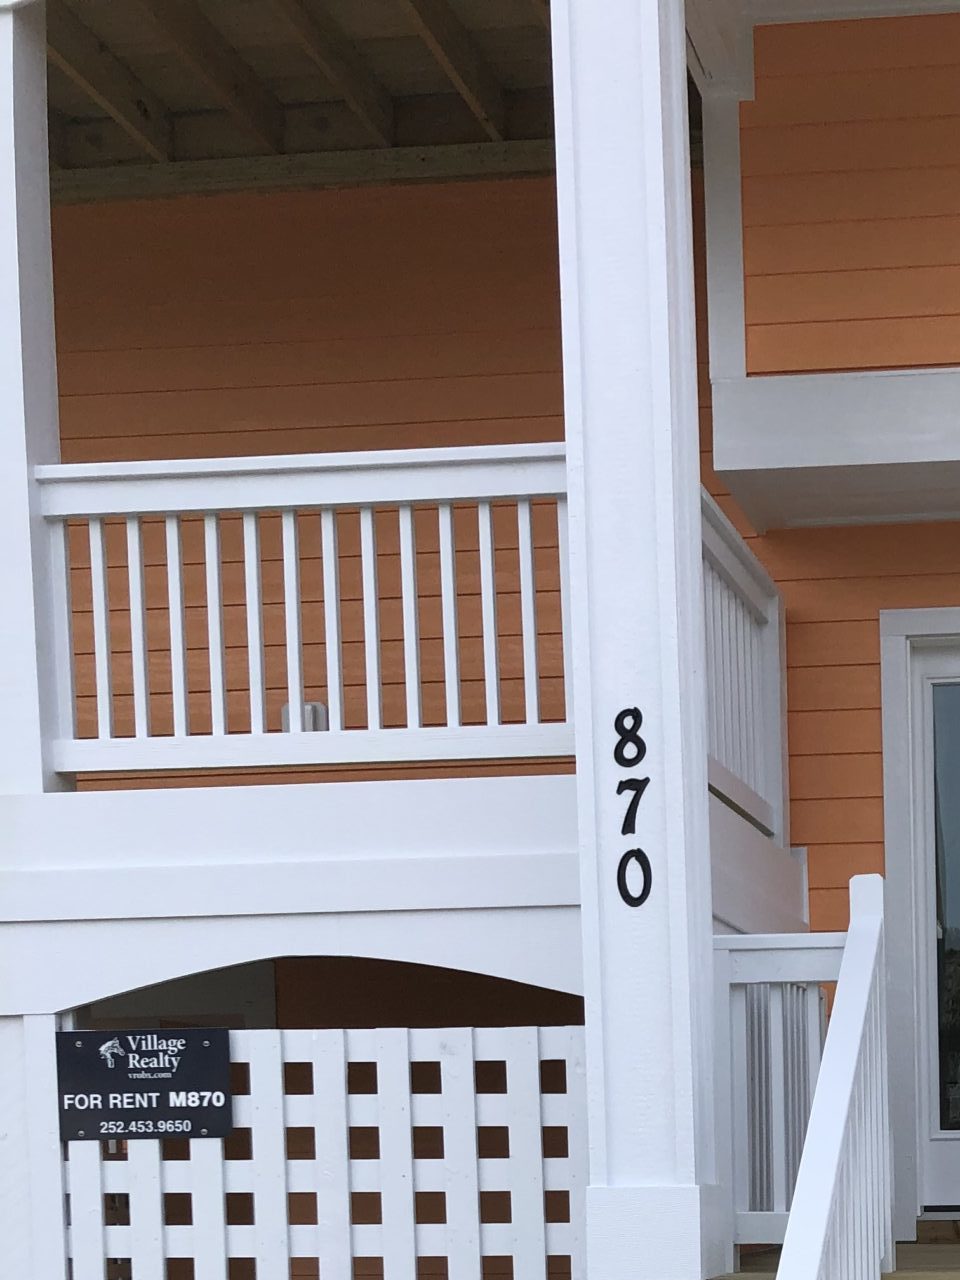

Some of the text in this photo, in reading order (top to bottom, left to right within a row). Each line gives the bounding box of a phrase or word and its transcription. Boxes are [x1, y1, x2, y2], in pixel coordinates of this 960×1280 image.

[614, 707, 652, 908] 870
[126, 1034, 187, 1055] Village
[127, 1053, 181, 1072] Realty
[63, 1091, 225, 1110] FOR RENT M870
[100, 1120, 192, 1134] 252.453.9650
